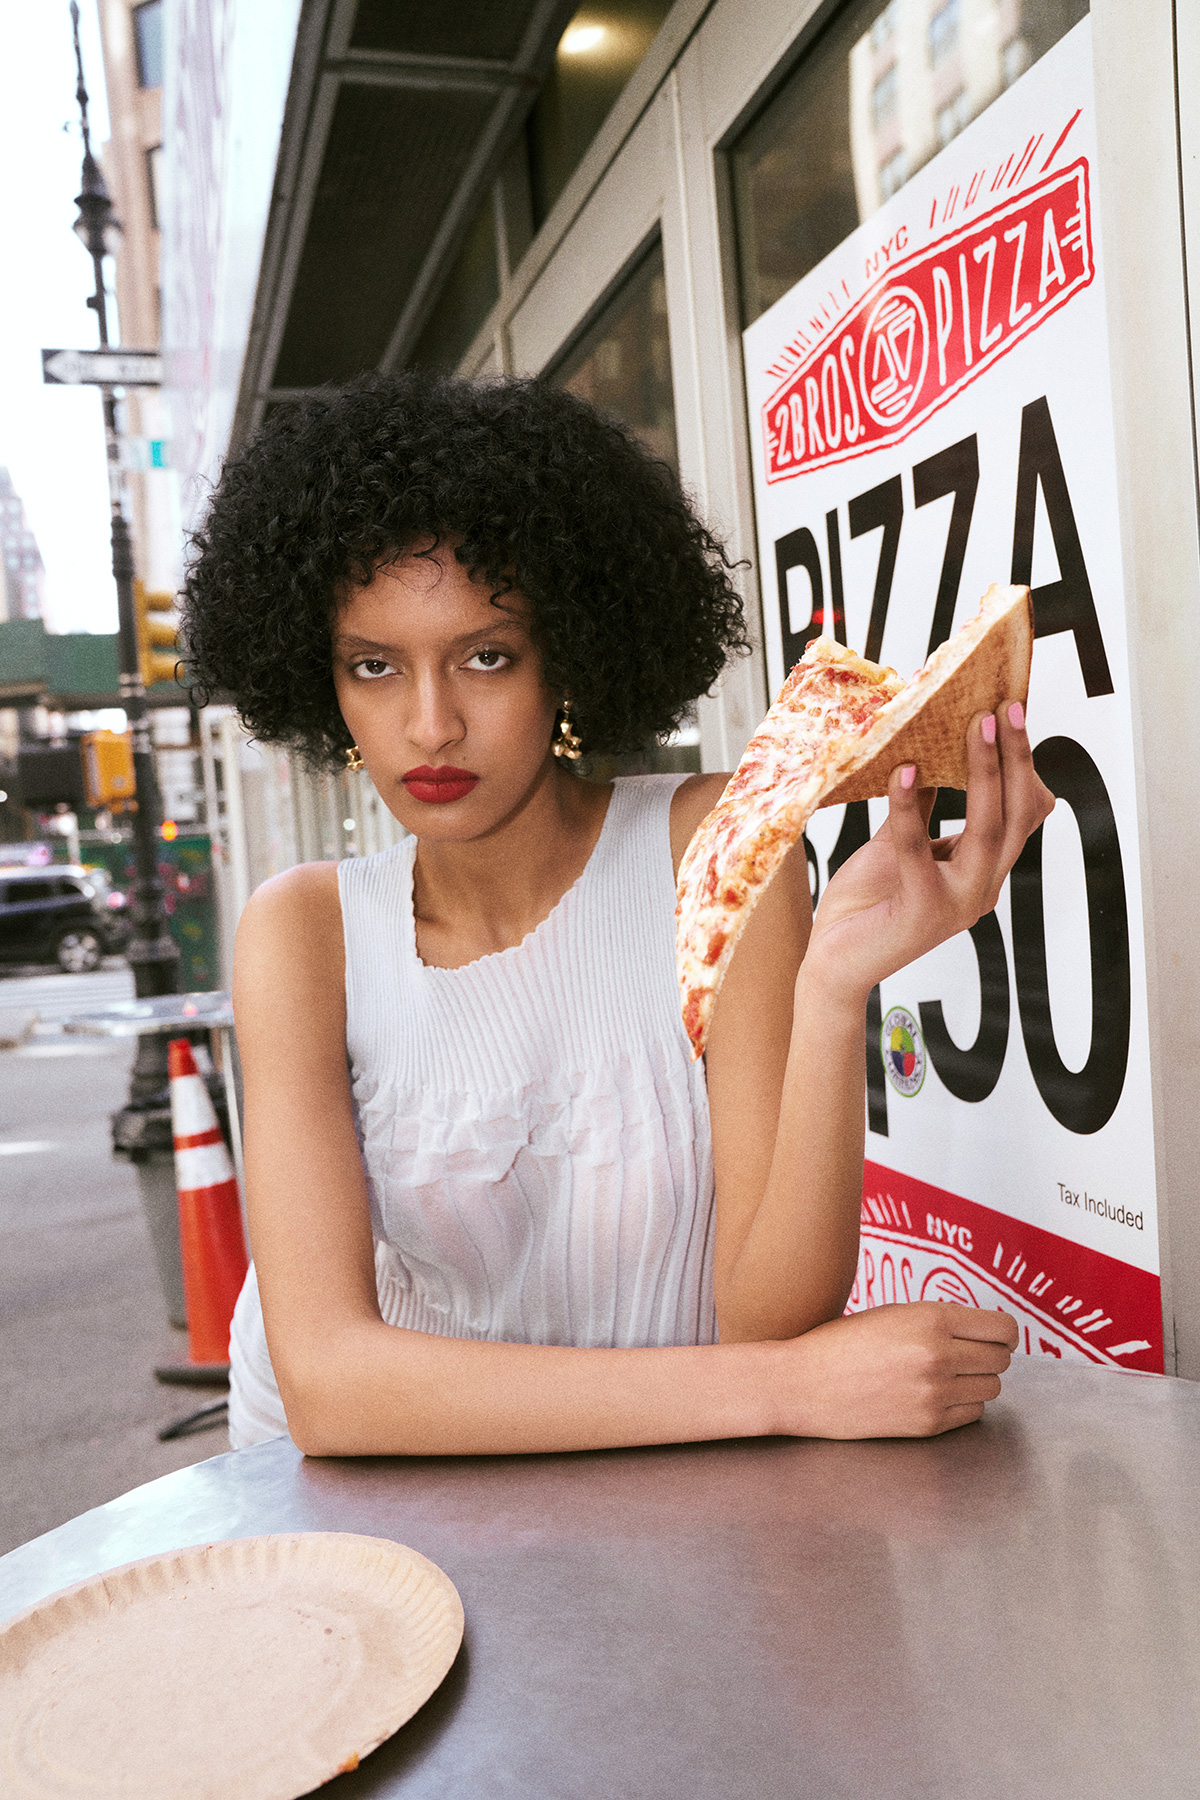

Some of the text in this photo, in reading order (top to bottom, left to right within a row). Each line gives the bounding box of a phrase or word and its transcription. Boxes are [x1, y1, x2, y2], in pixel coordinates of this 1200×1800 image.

[865, 225, 908, 279] NYC
[932, 208, 1066, 386] PIZZA
[774, 394, 1115, 698] PIZZA
[926, 1213, 973, 1252] NYC
[1057, 1182, 1144, 1231] Tax Included
